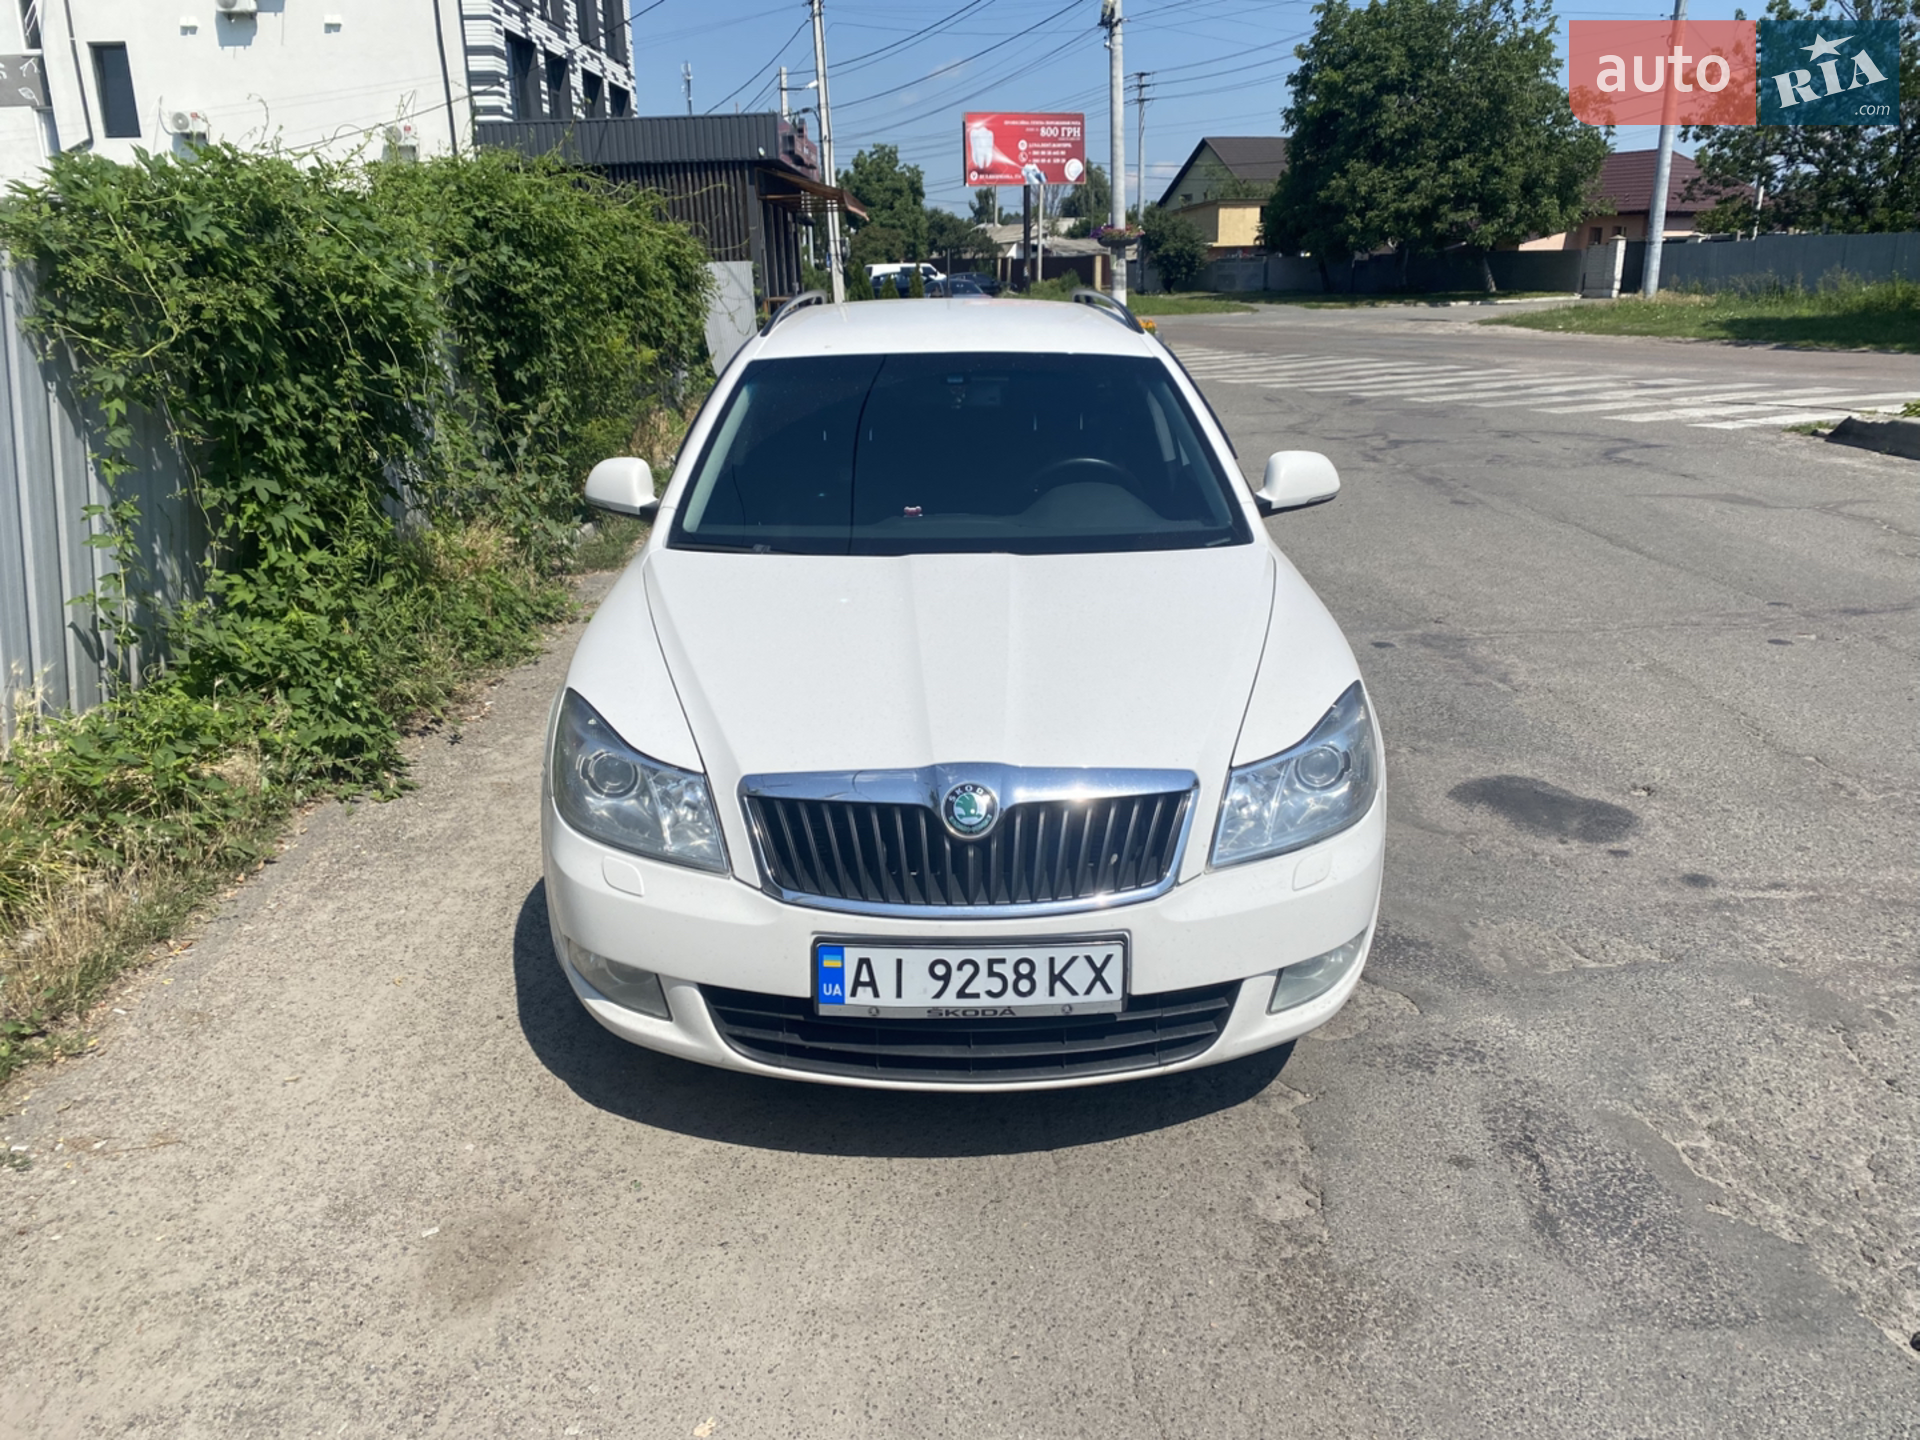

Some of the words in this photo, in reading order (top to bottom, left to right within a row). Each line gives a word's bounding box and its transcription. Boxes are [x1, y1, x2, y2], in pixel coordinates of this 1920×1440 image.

[1040, 126, 1059, 138] 800
[1061, 126, 1081, 138] ГРН
[948, 784, 991, 803] SKOD
[928, 957, 1037, 999] 9258
[823, 983, 843, 997] UA
